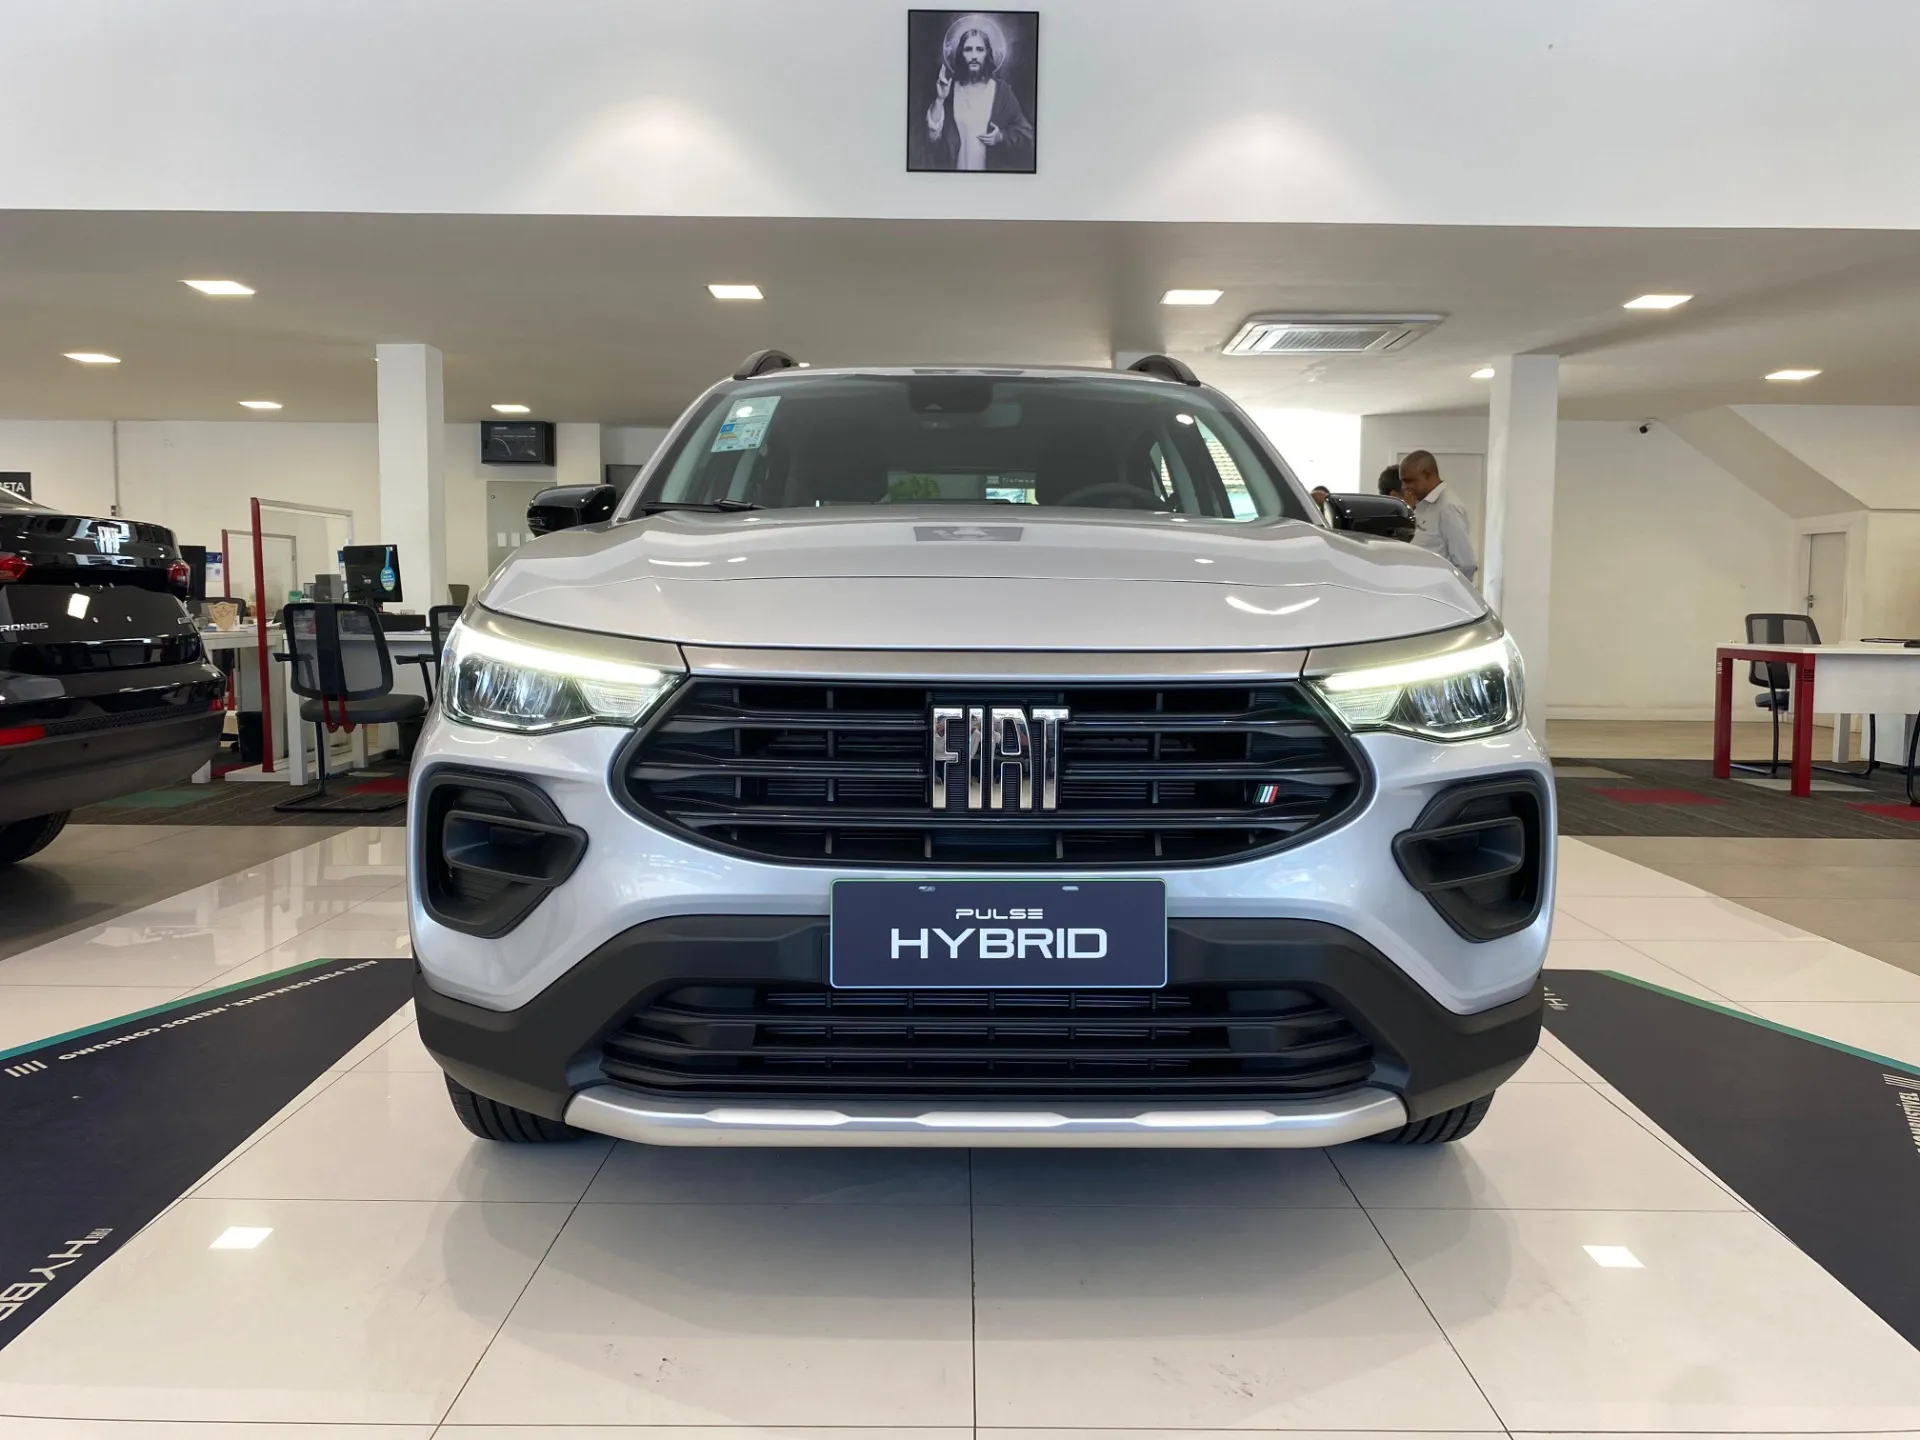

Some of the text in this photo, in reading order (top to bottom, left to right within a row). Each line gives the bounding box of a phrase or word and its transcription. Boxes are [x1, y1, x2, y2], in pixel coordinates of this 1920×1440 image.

[0, 482, 26, 492] ETA
[932, 707, 1070, 810] FIAT
[955, 908, 1044, 920] PULSE
[890, 927, 1108, 959] HYBRID
[160, 1007, 228, 1029] MENOS
[58, 1027, 161, 1060] CONSUMO
